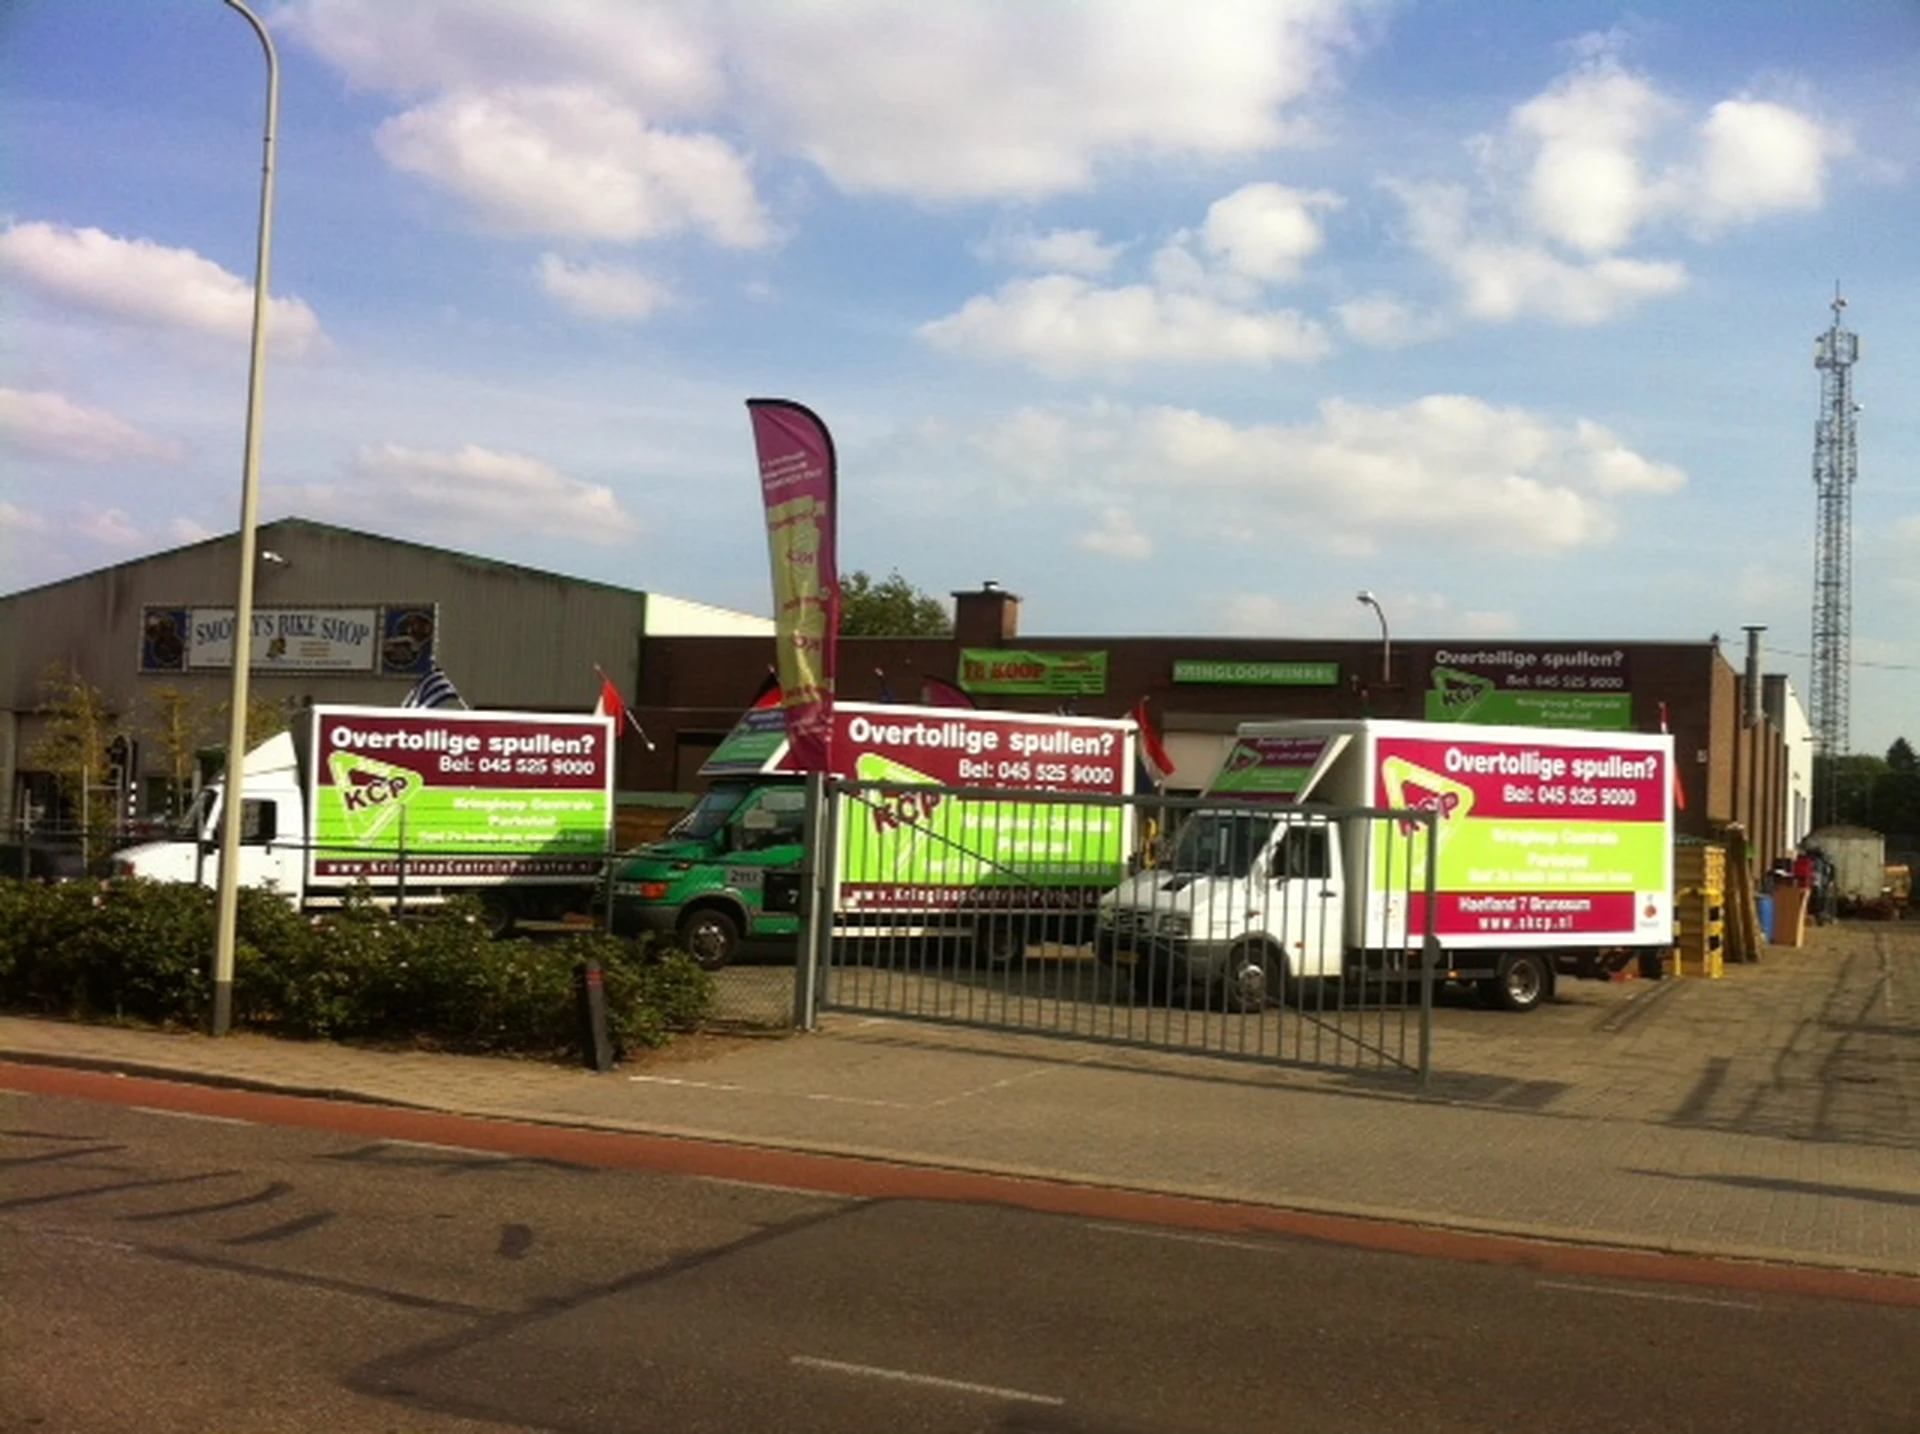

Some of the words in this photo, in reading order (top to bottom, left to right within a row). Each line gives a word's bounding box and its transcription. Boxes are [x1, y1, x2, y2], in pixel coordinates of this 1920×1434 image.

[279, 614, 318, 637] BIKE
[322, 617, 370, 646] SHOP
[1435, 650, 1537, 669] Overtollige
[1542, 651, 1624, 670] spullen?
[330, 726, 481, 755] Overtollige
[488, 734, 596, 756] spullen?
[849, 717, 999, 755] Overtollige
[1009, 732, 1115, 757] spullen?
[438, 756, 474, 773] Bel:
[478, 757, 511, 773] 045
[515, 758, 548, 774] 525
[552, 759, 596, 776] 9000
[958, 758, 993, 779] Bel:
[997, 761, 1030, 780] 045
[1035, 763, 1066, 781] 525
[1071, 764, 1115, 784] 9000
[1445, 748, 1566, 780] Overtollige
[1571, 755, 1658, 782] spullen?
[343, 776, 409, 811] KCP
[1503, 784, 1534, 803] Bel:
[1538, 786, 1567, 805] 045
[1570, 787, 1598, 805] 525
[1600, 788, 1637, 806] 9000
[1519, 896, 1528, 911] 7
[1478, 914, 1574, 932] www.skcp.nl
